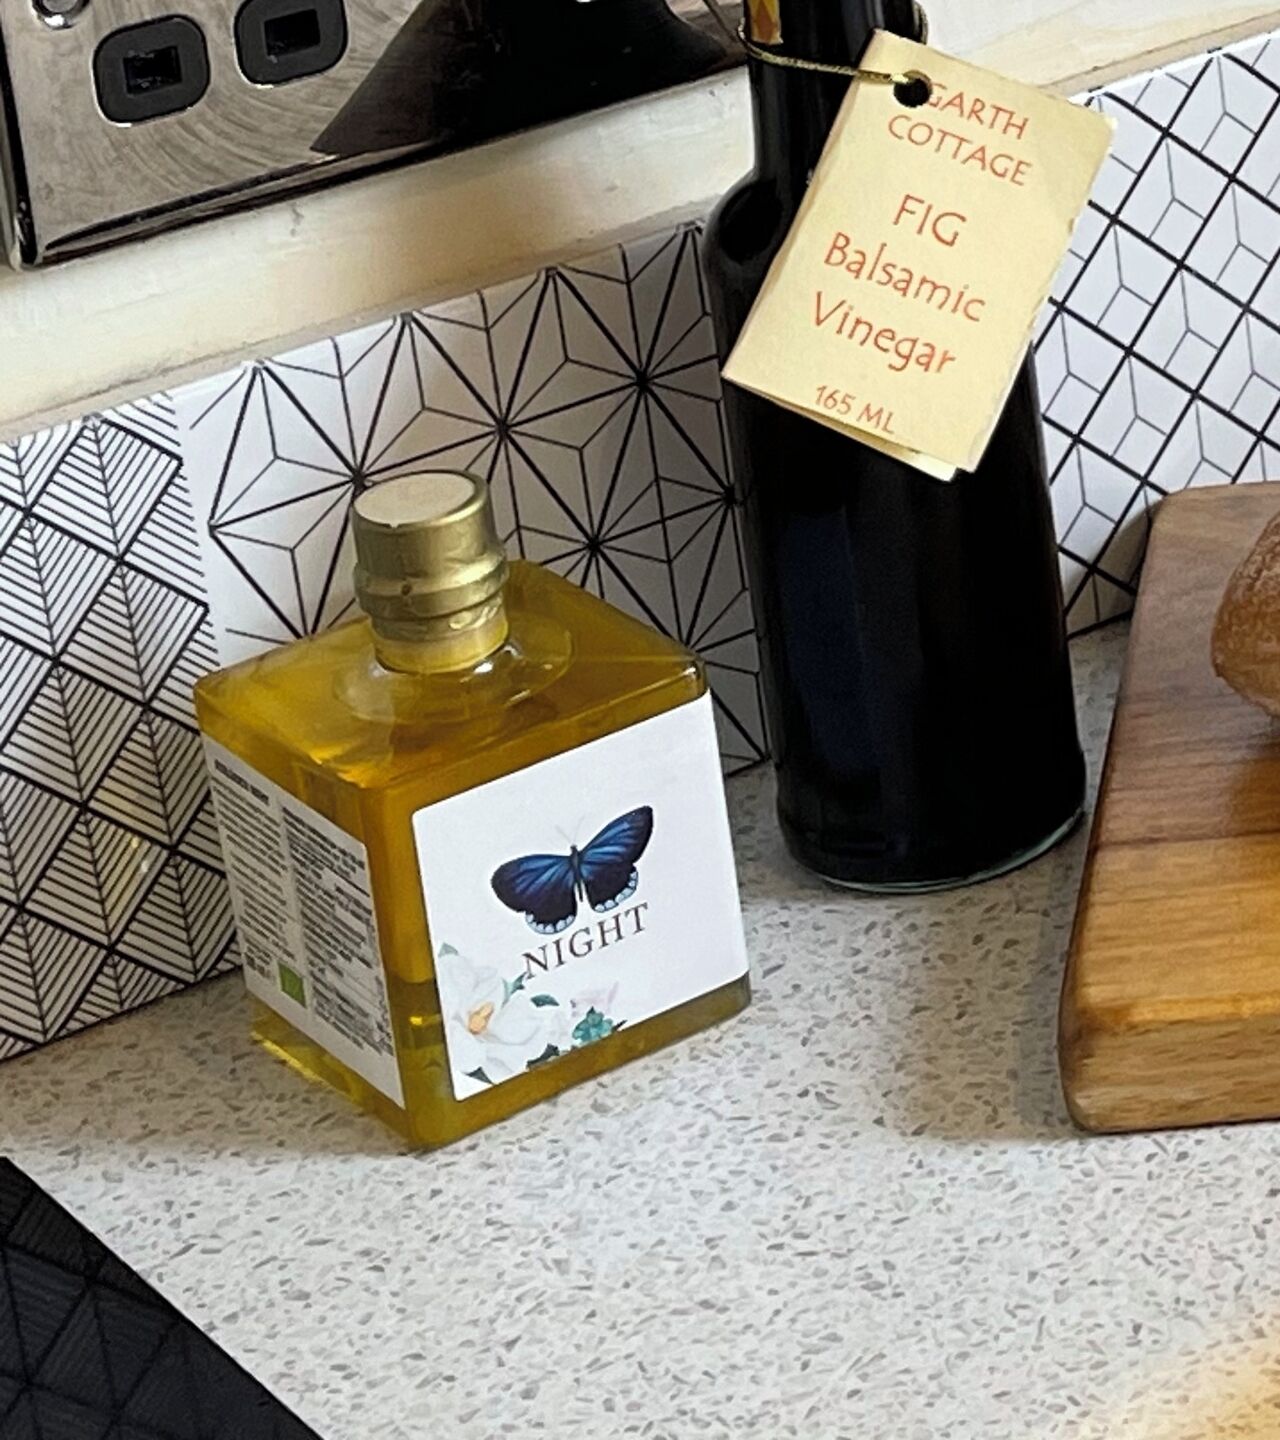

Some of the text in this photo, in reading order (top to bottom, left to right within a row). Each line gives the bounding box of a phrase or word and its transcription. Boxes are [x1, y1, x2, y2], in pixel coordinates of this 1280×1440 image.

[888, 114, 1033, 186] COTTAGE
[892, 193, 967, 248] FIG
[823, 231, 987, 323] Balsamic
[812, 290, 957, 374] Vinegar
[815, 384, 896, 436] 165 ML
[521, 901, 650, 981] NIGHT
